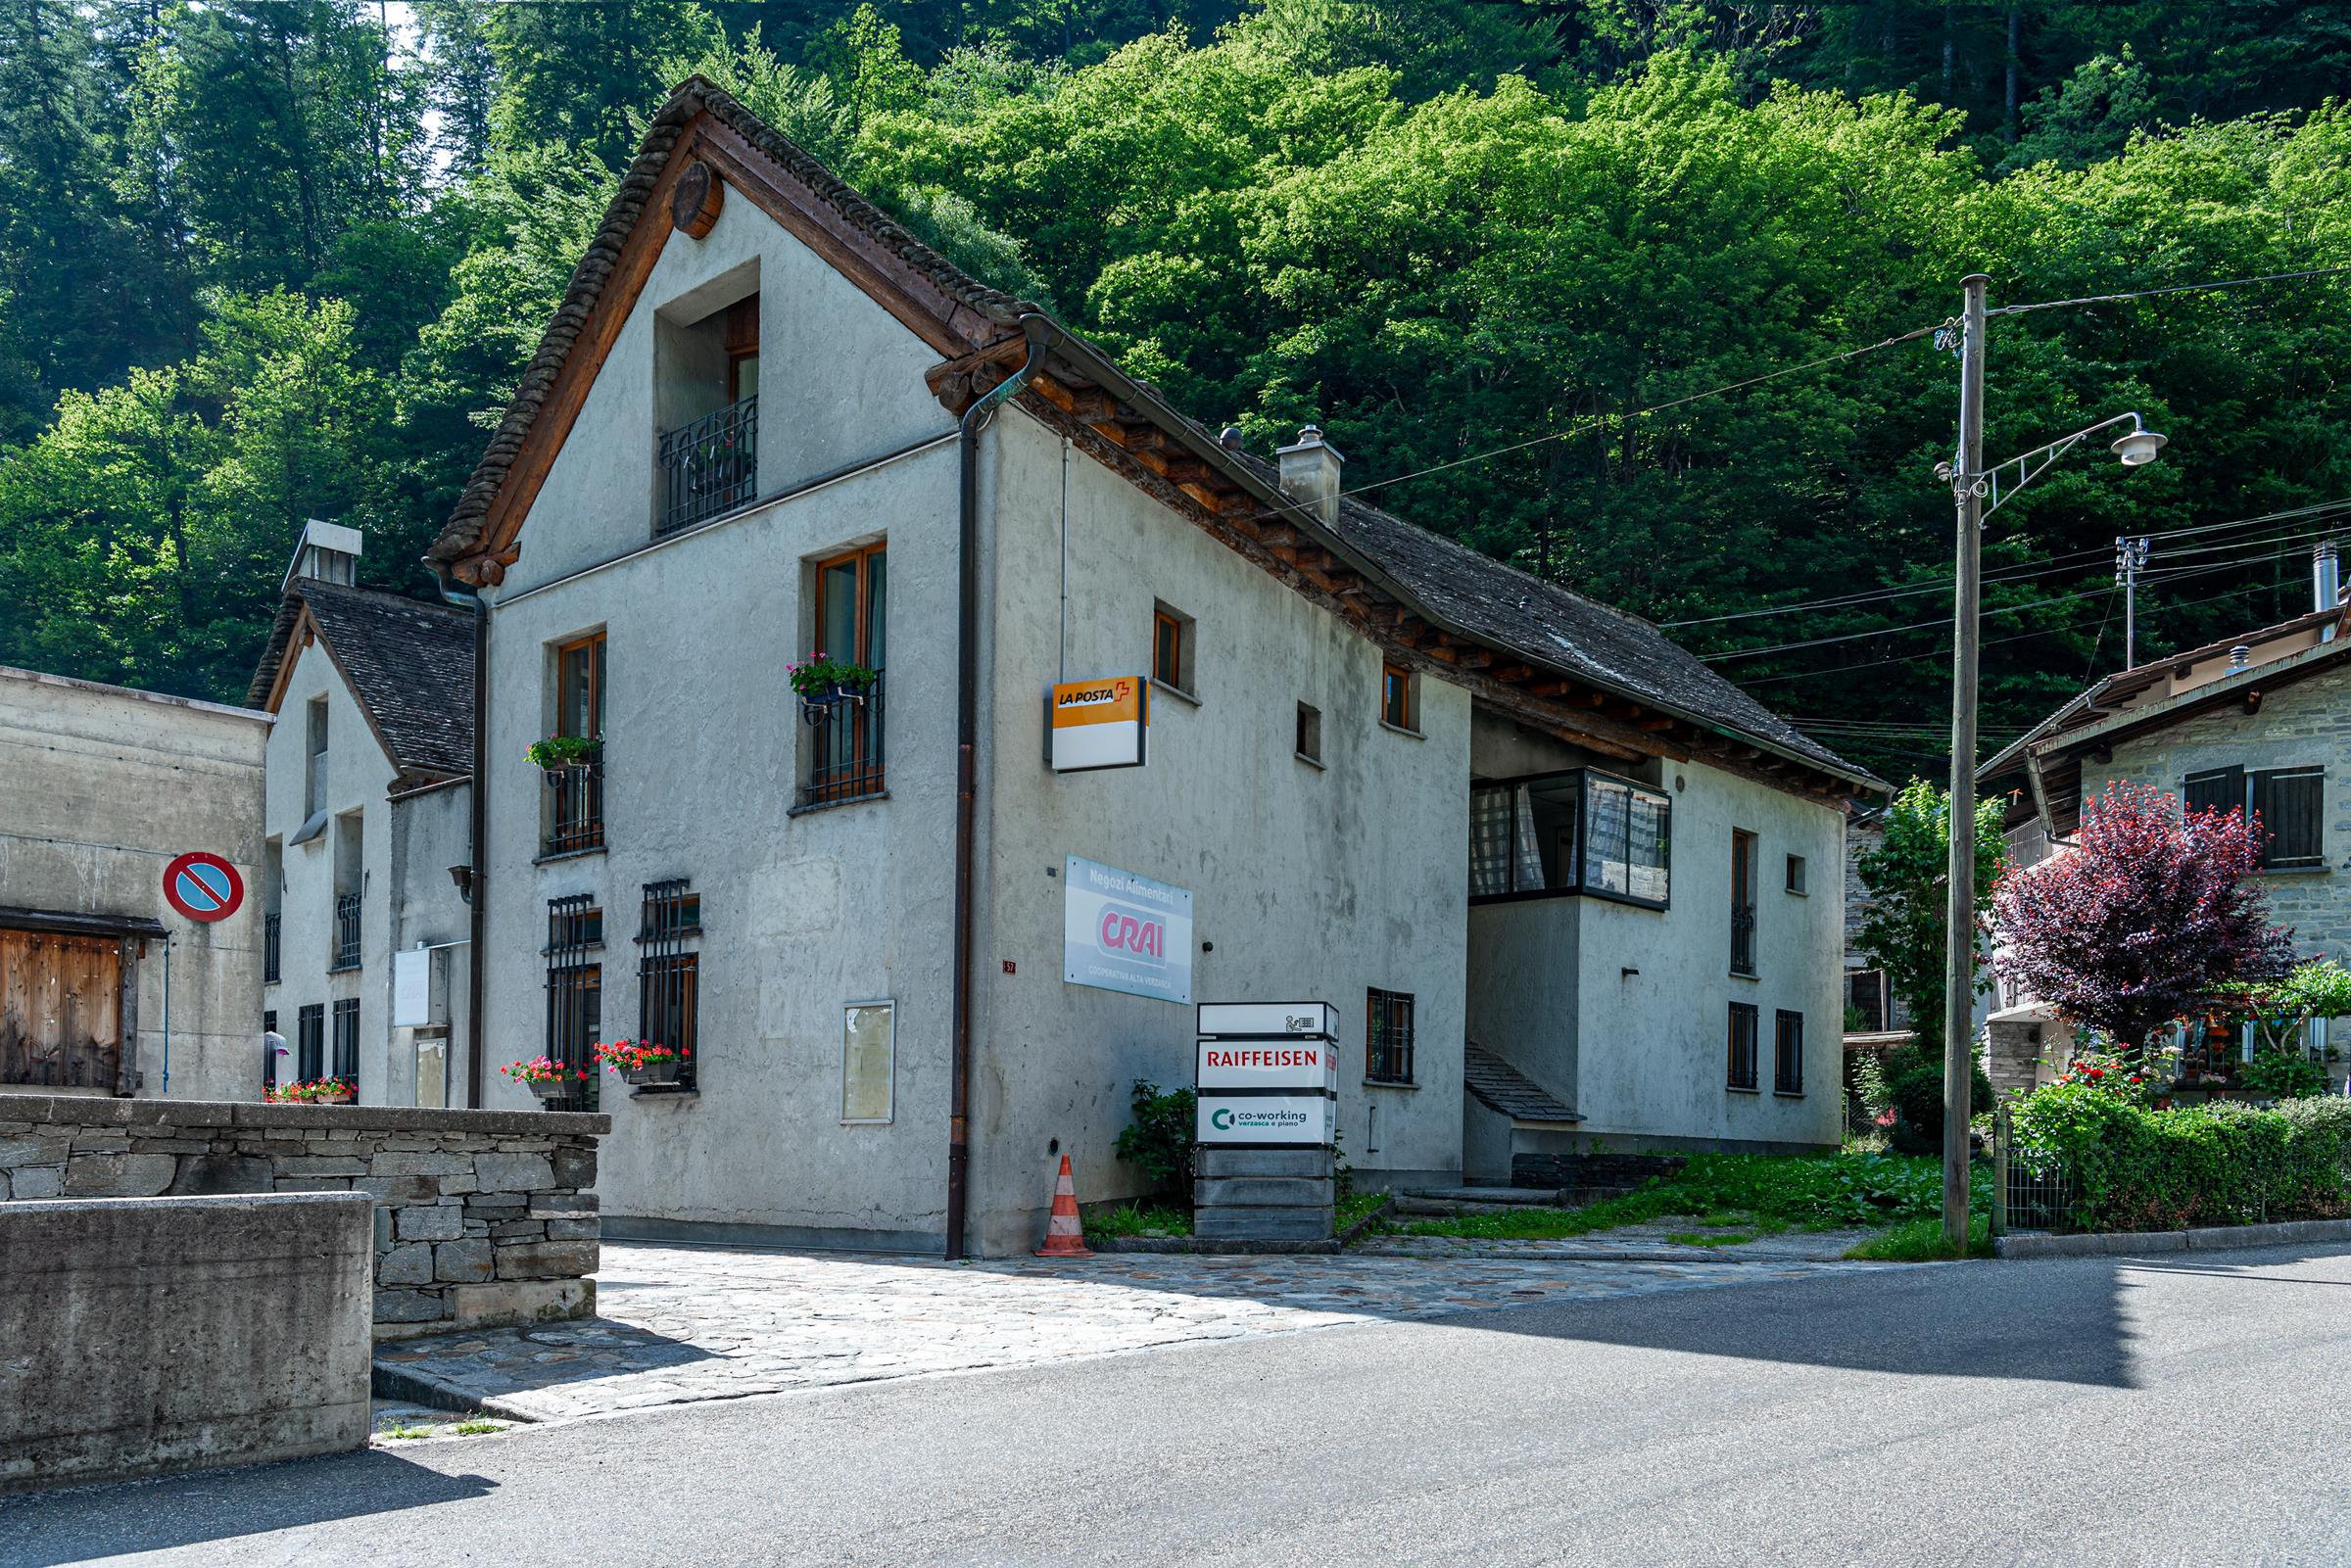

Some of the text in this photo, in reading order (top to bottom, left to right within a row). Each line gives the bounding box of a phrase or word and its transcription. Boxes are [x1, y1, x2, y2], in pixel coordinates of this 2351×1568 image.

[1059, 689, 1114, 705] LA POSTA
[1089, 869, 1174, 905] Negozi Alimentari
[1101, 912, 1163, 958] CRAI
[1088, 965, 1172, 988] COOPERATIVA ALTA VERZASCA
[1207, 1050, 1318, 1067] RAIFFEISEN
[1238, 1110, 1307, 1123] co-working
